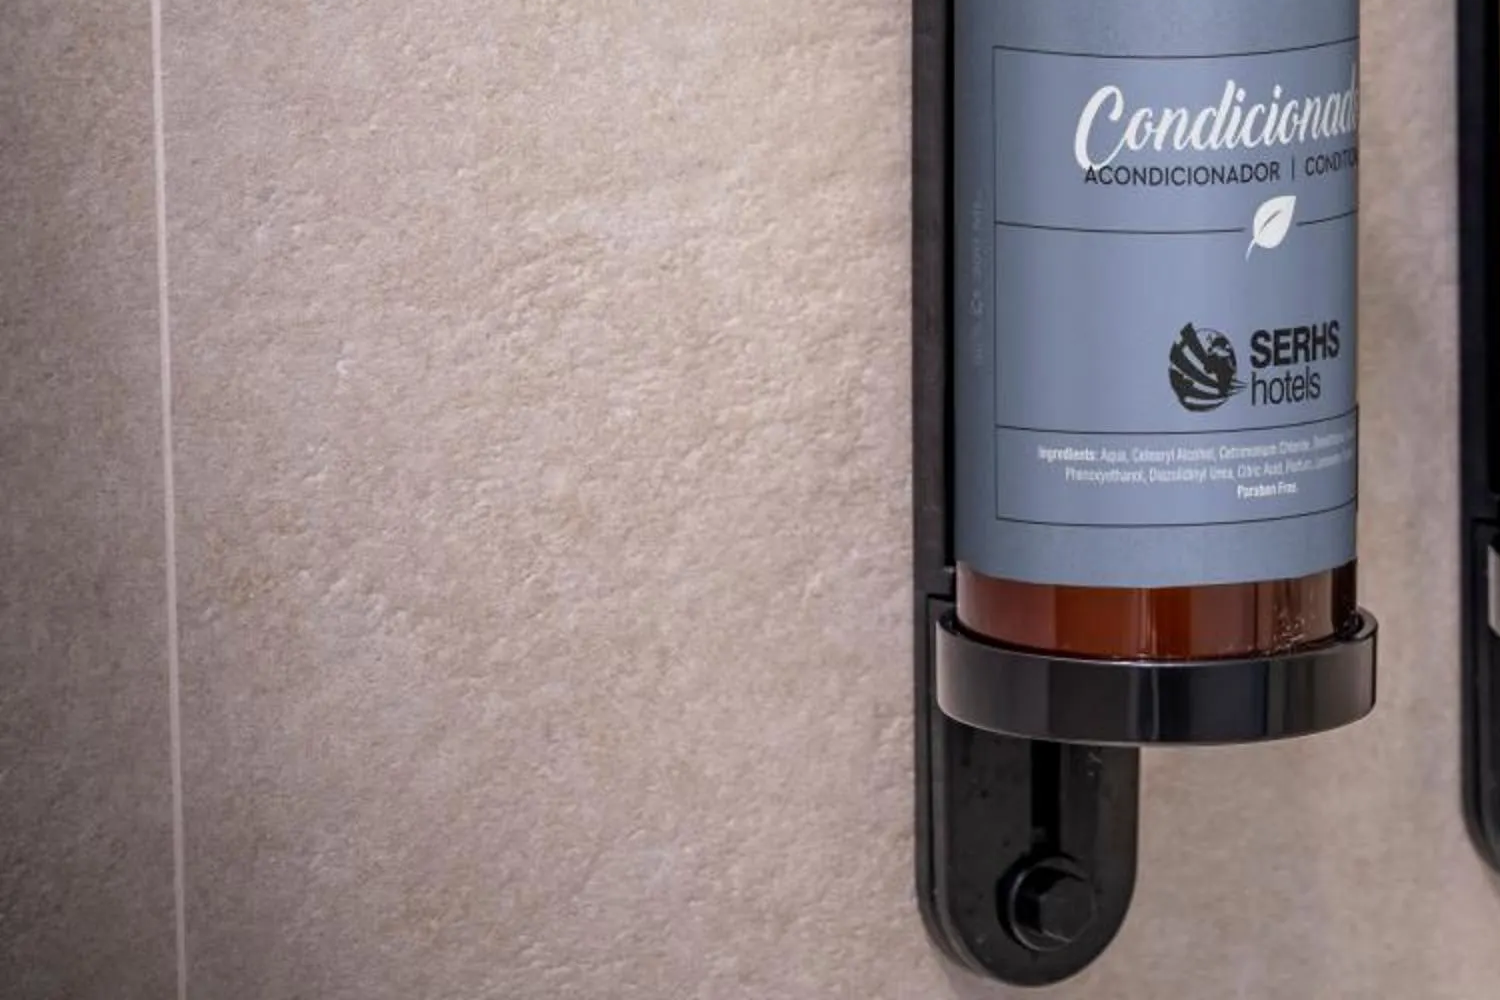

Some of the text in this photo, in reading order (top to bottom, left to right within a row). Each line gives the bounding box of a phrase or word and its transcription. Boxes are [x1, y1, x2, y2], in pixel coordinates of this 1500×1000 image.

[1083, 161, 1281, 187] ACONDICIONADOR
[1250, 319, 1341, 369] SERHS
[1251, 366, 1322, 406] hotels
